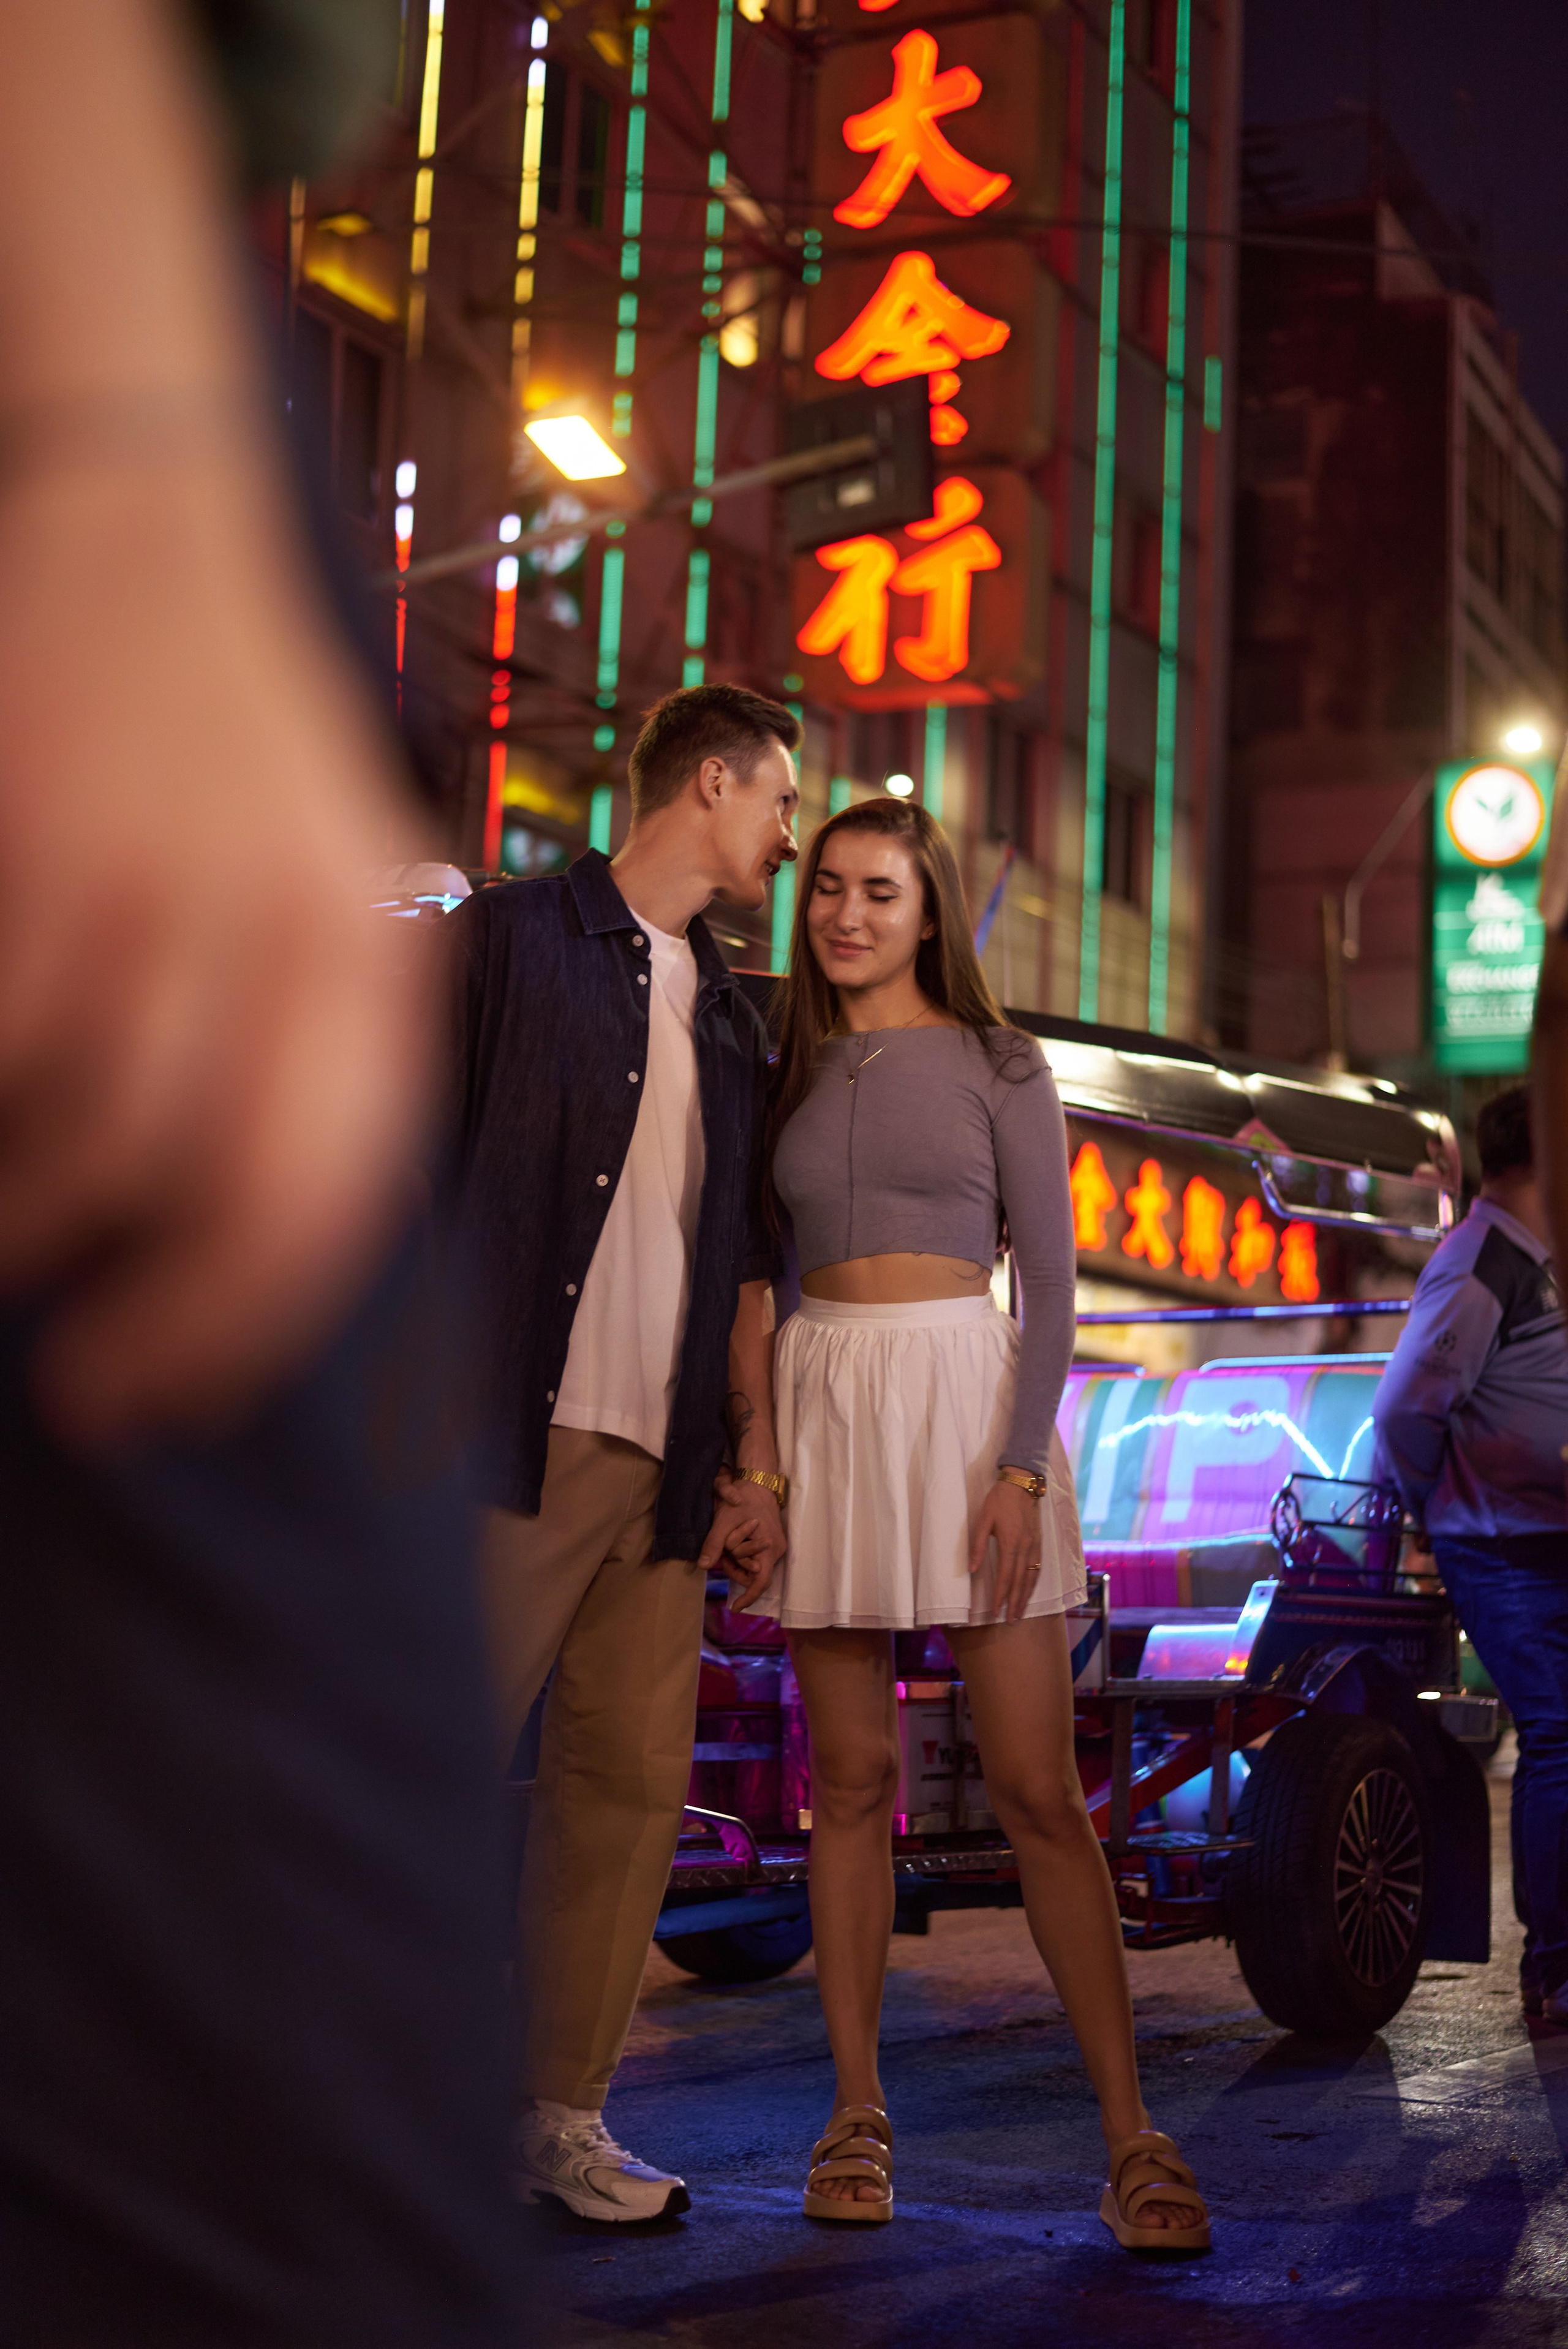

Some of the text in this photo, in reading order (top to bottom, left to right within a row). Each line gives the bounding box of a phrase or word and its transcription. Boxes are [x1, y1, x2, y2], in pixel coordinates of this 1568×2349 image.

[796, 0, 1012, 685] 大金行
[1058, 1376, 1290, 1523] IP
[537, 2140, 572, 2173] N
